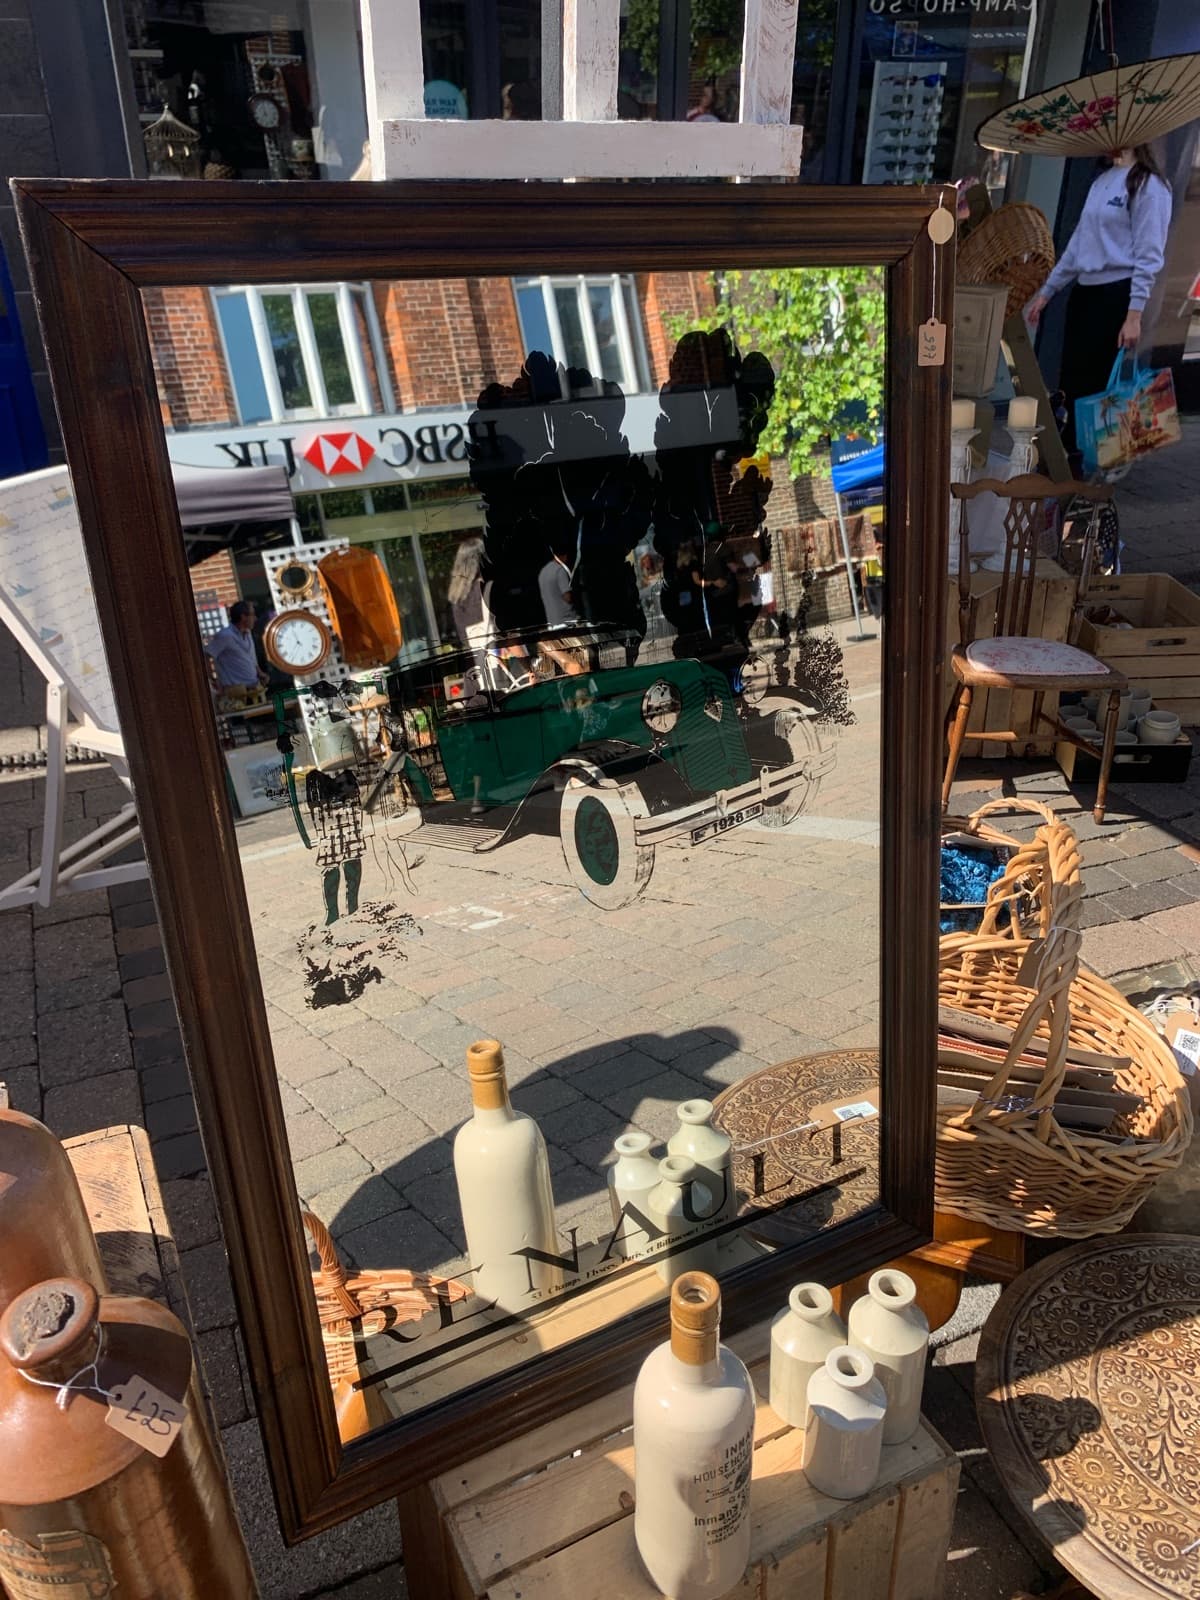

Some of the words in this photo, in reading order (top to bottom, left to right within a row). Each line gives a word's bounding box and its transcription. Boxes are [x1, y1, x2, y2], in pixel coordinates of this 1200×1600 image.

[712, 811, 745, 834] 1928
[349, 1112, 866, 1364] RENAULT
[125, 1390, 177, 1436] £25
